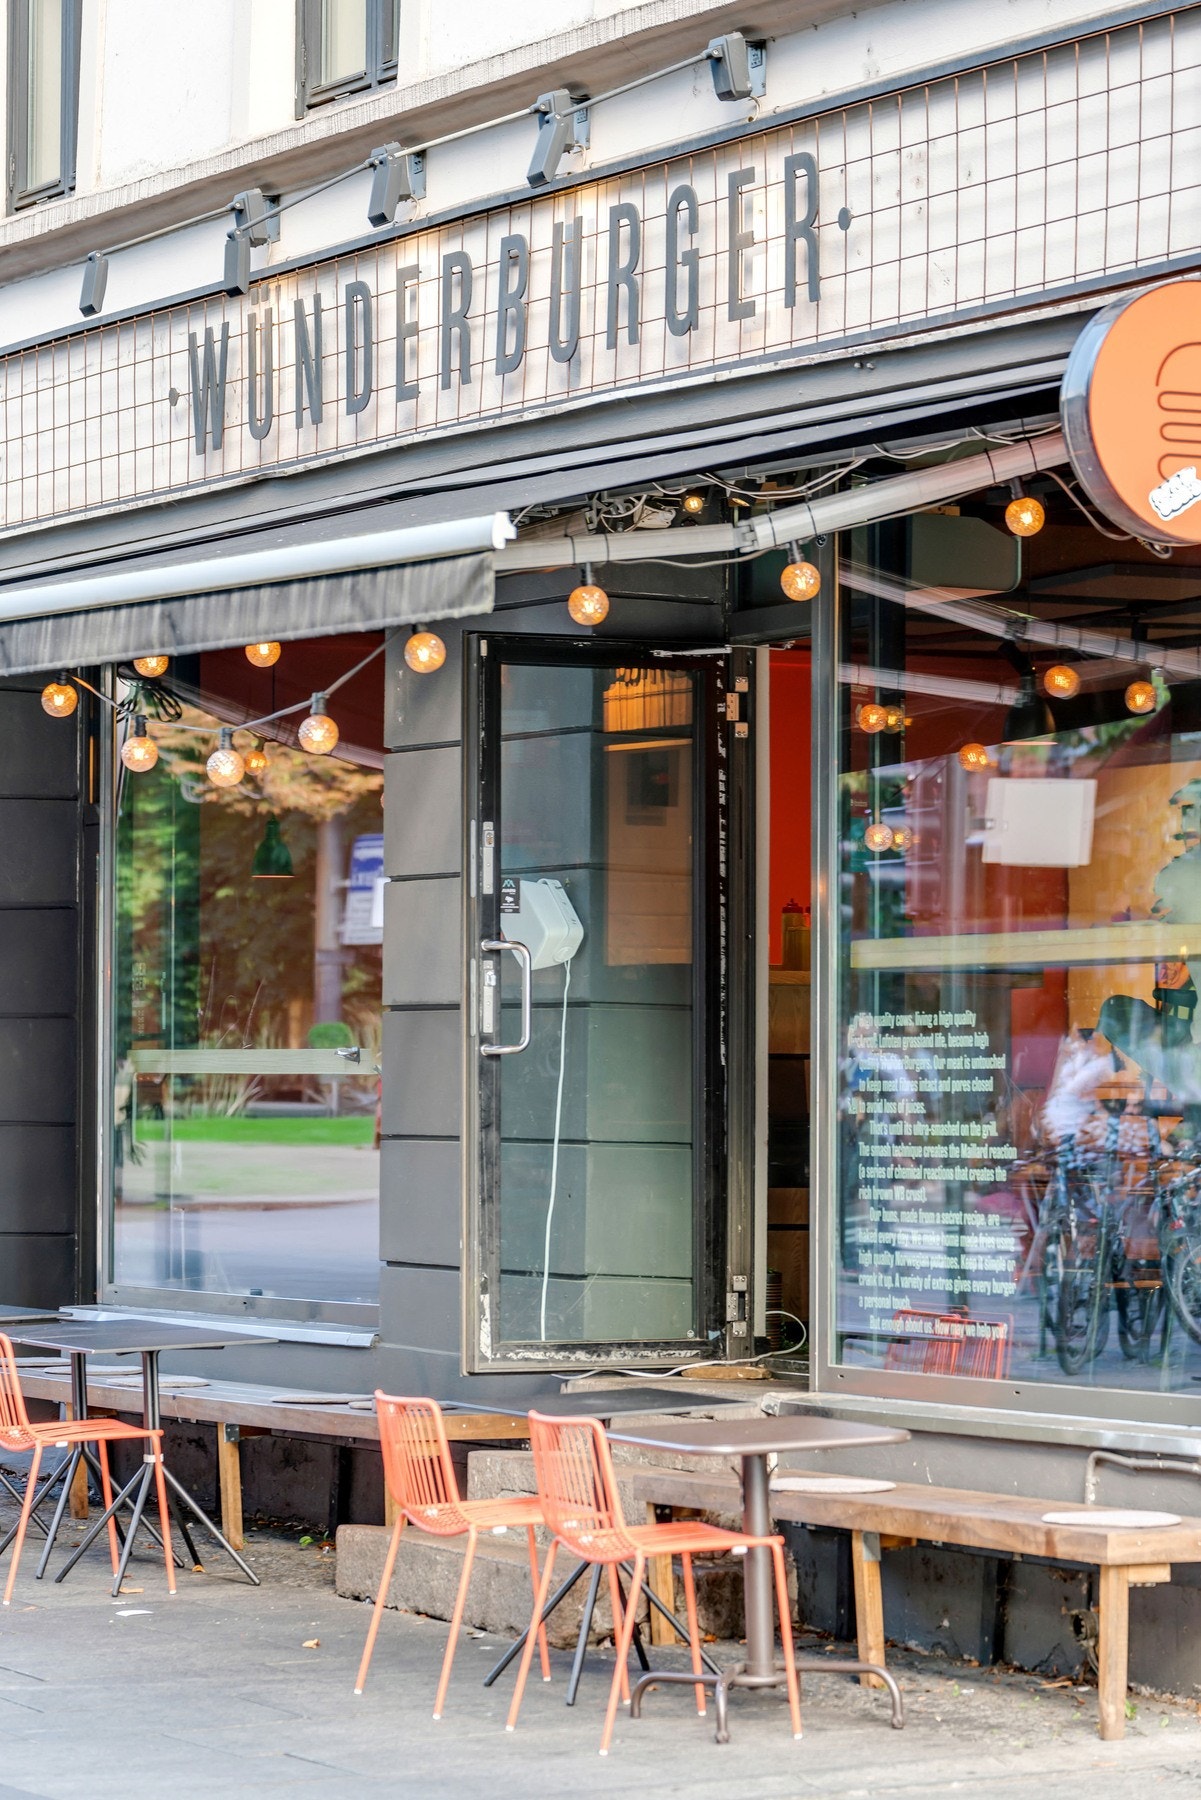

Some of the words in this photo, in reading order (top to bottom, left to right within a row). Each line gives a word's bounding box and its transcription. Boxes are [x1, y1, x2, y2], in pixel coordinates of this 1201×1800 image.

[189, 152, 821, 455] WÜNDERBURGER
[874, 1012, 894, 1028] quality
[915, 1011, 932, 1027] living
[939, 1010, 953, 1027] high
[954, 1010, 976, 1027] quality
[879, 1034, 901, 1048] Lofoten
[903, 1033, 934, 1050] grassland
[948, 1032, 973, 1047] become
[974, 1032, 989, 1049] high
[933, 1055, 946, 1069] Our
[947, 1056, 963, 1069] meat
[971, 1054, 1006, 1069] untouched
[866, 1078, 881, 1094] keep
[882, 1078, 898, 1092] meat
[919, 1077, 938, 1092] intact
[938, 1077, 950, 1092] and
[952, 1079, 970, 1094] pores
[972, 1077, 993, 1092] closed
[866, 1099, 883, 1113] avoid
[884, 1099, 896, 1113] loss
[913, 1121, 960, 1136] ultra-smashed
[961, 1124, 969, 1136] on
[970, 1121, 981, 1136] the
[982, 1121, 998, 1140] grill.
[859, 1142, 870, 1156] The
[871, 1143, 891, 1156] smash
[892, 1143, 922, 1159] technique
[923, 1144, 948, 1158] creates
[949, 1143, 960, 1158] the
[960, 1143, 988, 1158] Maillard
[989, 1144, 1017, 1159] reaction
[866, 1165, 886, 1179] series
[894, 1165, 922, 1179] chemical
[923, 1166, 954, 1180] reactions
[955, 1166, 968, 1180] that
[969, 1167, 994, 1181] creates
[995, 1166, 1006, 1181] the
[859, 1185, 871, 1200] rich
[872, 1186, 893, 1200] brown
[894, 1186, 905, 1200] WB
[870, 1207, 881, 1221] Our
[900, 1209, 918, 1223] made
[919, 1210, 936, 1224] from
[988, 1213, 1000, 1226] are
[878, 1232, 896, 1246] every
[960, 1233, 978, 1248] made
[979, 1233, 995, 1248] fries
[996, 1234, 1014, 1251] using
[858, 1250, 872, 1266] high
[873, 1251, 894, 1268] quality
[895, 1251, 930, 1270] Norwegian
[961, 1254, 977, 1270] Keep
[984, 1255, 1006, 1272] simple
[1007, 1259, 1016, 1270] or
[858, 1273, 876, 1287] crank
[884, 1276, 894, 1290] up.
[901, 1275, 922, 1292] variety
[932, 1277, 953, 1293] extras
[954, 1277, 971, 1295] gives
[972, 1279, 991, 1296] every
[992, 1277, 1016, 1297] burger
[864, 1295, 891, 1309] personal
[892, 1296, 912, 1309] touch.
[882, 1317, 904, 1334] enough
[905, 1316, 922, 1332] about
[924, 1320, 934, 1334] us.
[934, 1319, 949, 1337] How
[950, 1322, 964, 1338] may
[966, 1323, 975, 1338] we
[976, 1322, 991, 1340] help
